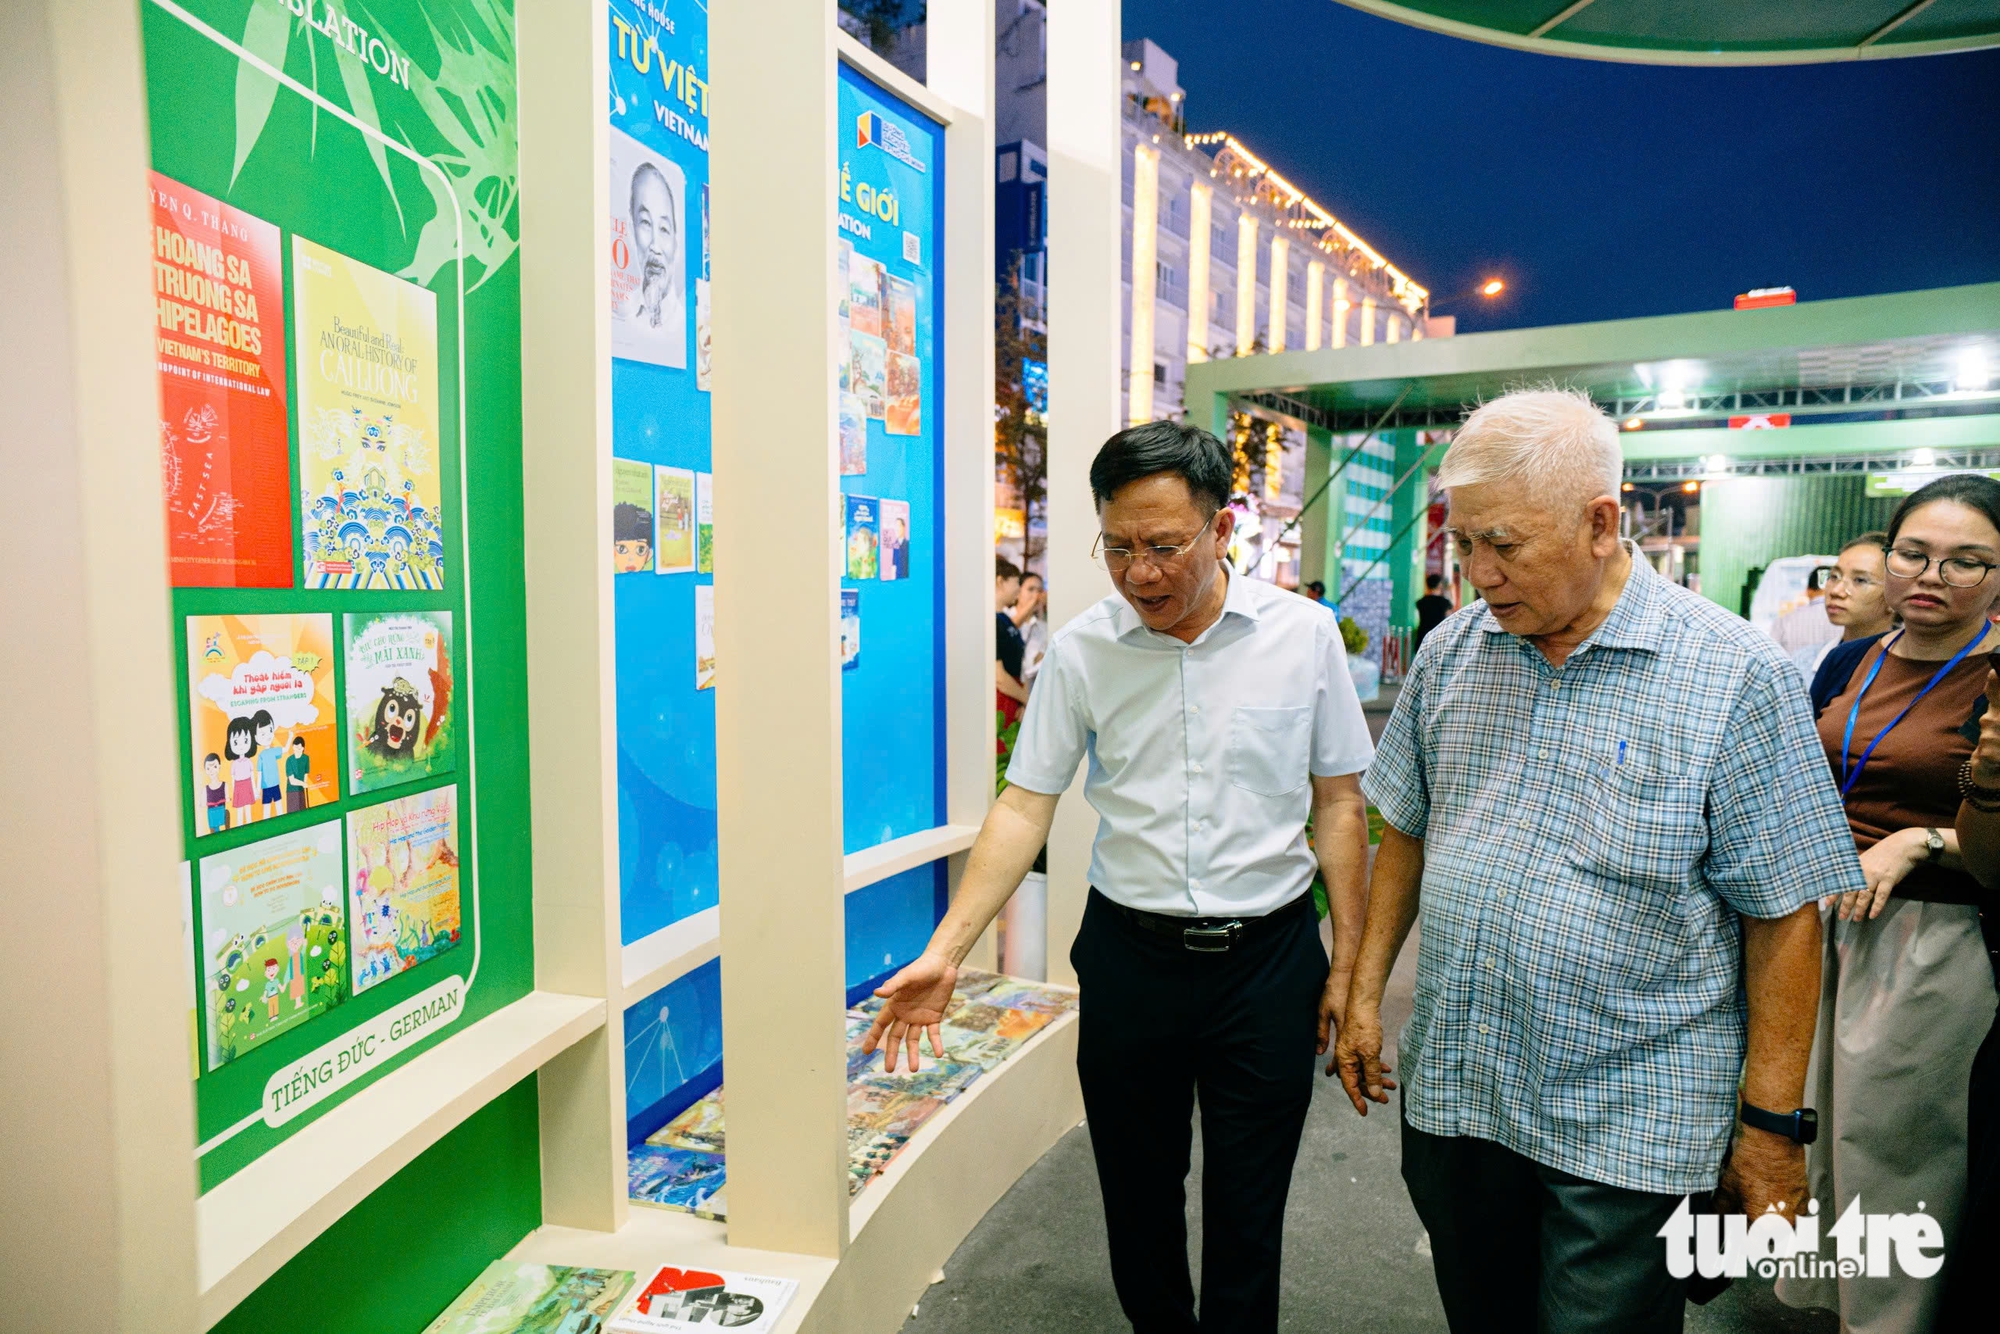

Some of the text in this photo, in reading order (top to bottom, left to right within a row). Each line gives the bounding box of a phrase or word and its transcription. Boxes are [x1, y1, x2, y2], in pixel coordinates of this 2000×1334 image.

[648, 3, 675, 35] HOUSE
[279, 0, 410, 90] SLATION
[613, 15, 709, 117] TỪ VIỆT
[182, 203, 198, 222] Q.
[202, 210, 249, 242] THANG
[856, 182, 899, 226] GIỚI
[156, 226, 226, 279] HOANG
[227, 254, 253, 289] SA
[154, 261, 259, 323] TRUONG SA
[320, 331, 418, 373] AN ORAL HISTORY OF
[333, 316, 370, 343] Beautiful
[370, 332, 385, 348] and
[157, 337, 260, 378] VIETNAM'S TERRITORY
[192, 370, 202, 381] OF
[202, 372, 256, 395] INTERNATIONAL
[257, 385, 271, 397] LAW
[260, 696, 276, 705] FROM
[271, 1060, 334, 1112] TIẾNG
[337, 1034, 376, 1073] ĐỨC
[389, 989, 459, 1041] GERMAN
